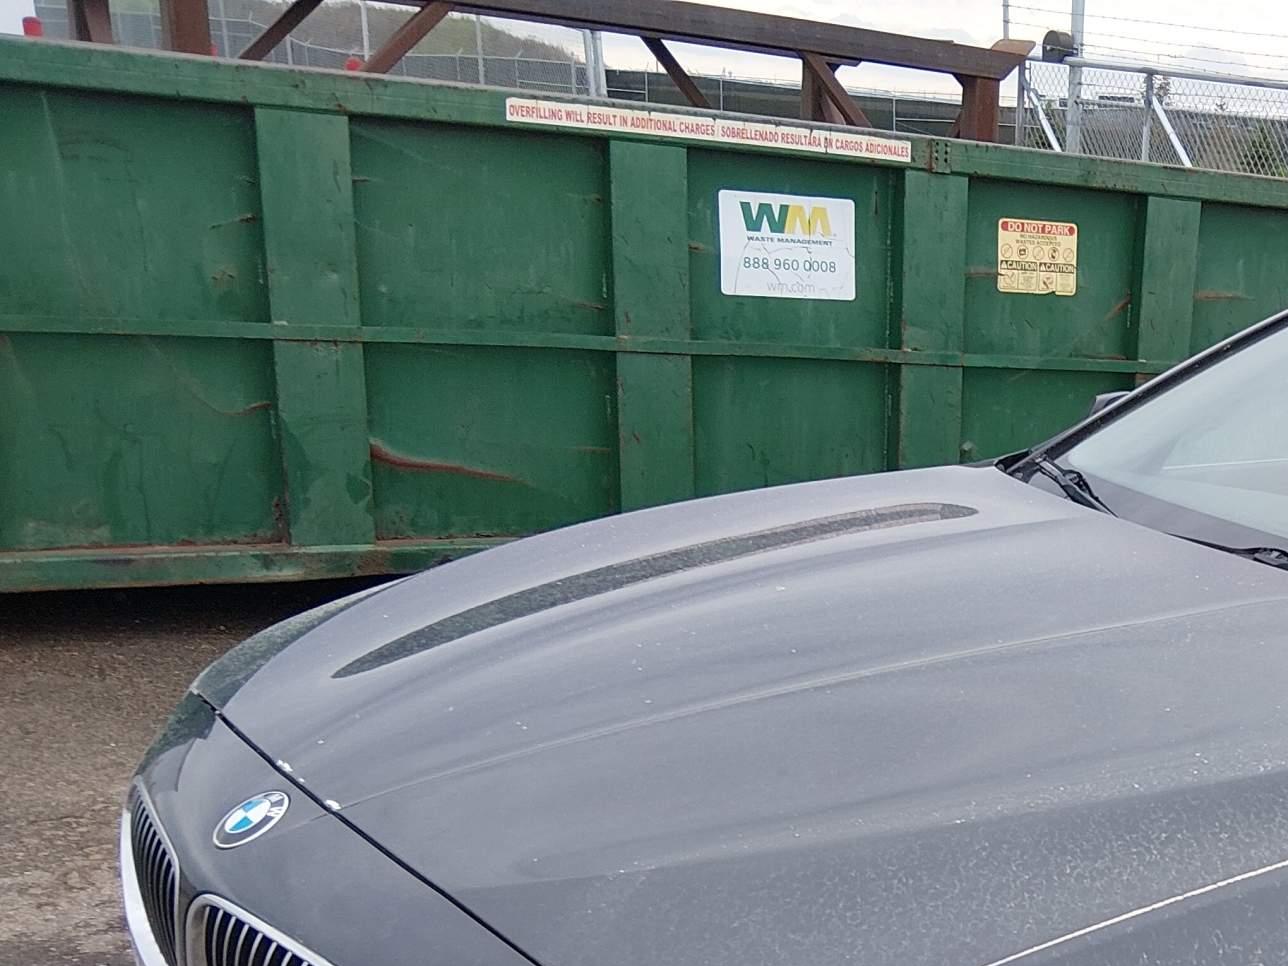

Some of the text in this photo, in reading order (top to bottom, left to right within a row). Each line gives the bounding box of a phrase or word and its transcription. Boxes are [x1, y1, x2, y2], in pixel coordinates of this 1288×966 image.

[508, 104, 563, 121] OVERFILLING
[565, 110, 585, 123] WILL
[587, 111, 618, 127] RESULT
[619, 115, 629, 126] IN
[630, 116, 678, 132] ADDITIONAL
[679, 121, 716, 136] CHARGES
[721, 126, 779, 143] SOBRELLENADO
[836, 139, 864, 153] CARGOS
[865, 142, 910, 158] ADICIONALES
[739, 201, 833, 238] WM
[1008, 222, 1071, 236] DO NOT PARK
[777, 237, 832, 247] MANAGEMENT
[743, 256, 837, 273] 888 960 0008
[1007, 261, 1037, 271] CAUTION
[1045, 264, 1074, 273] CAUTION
